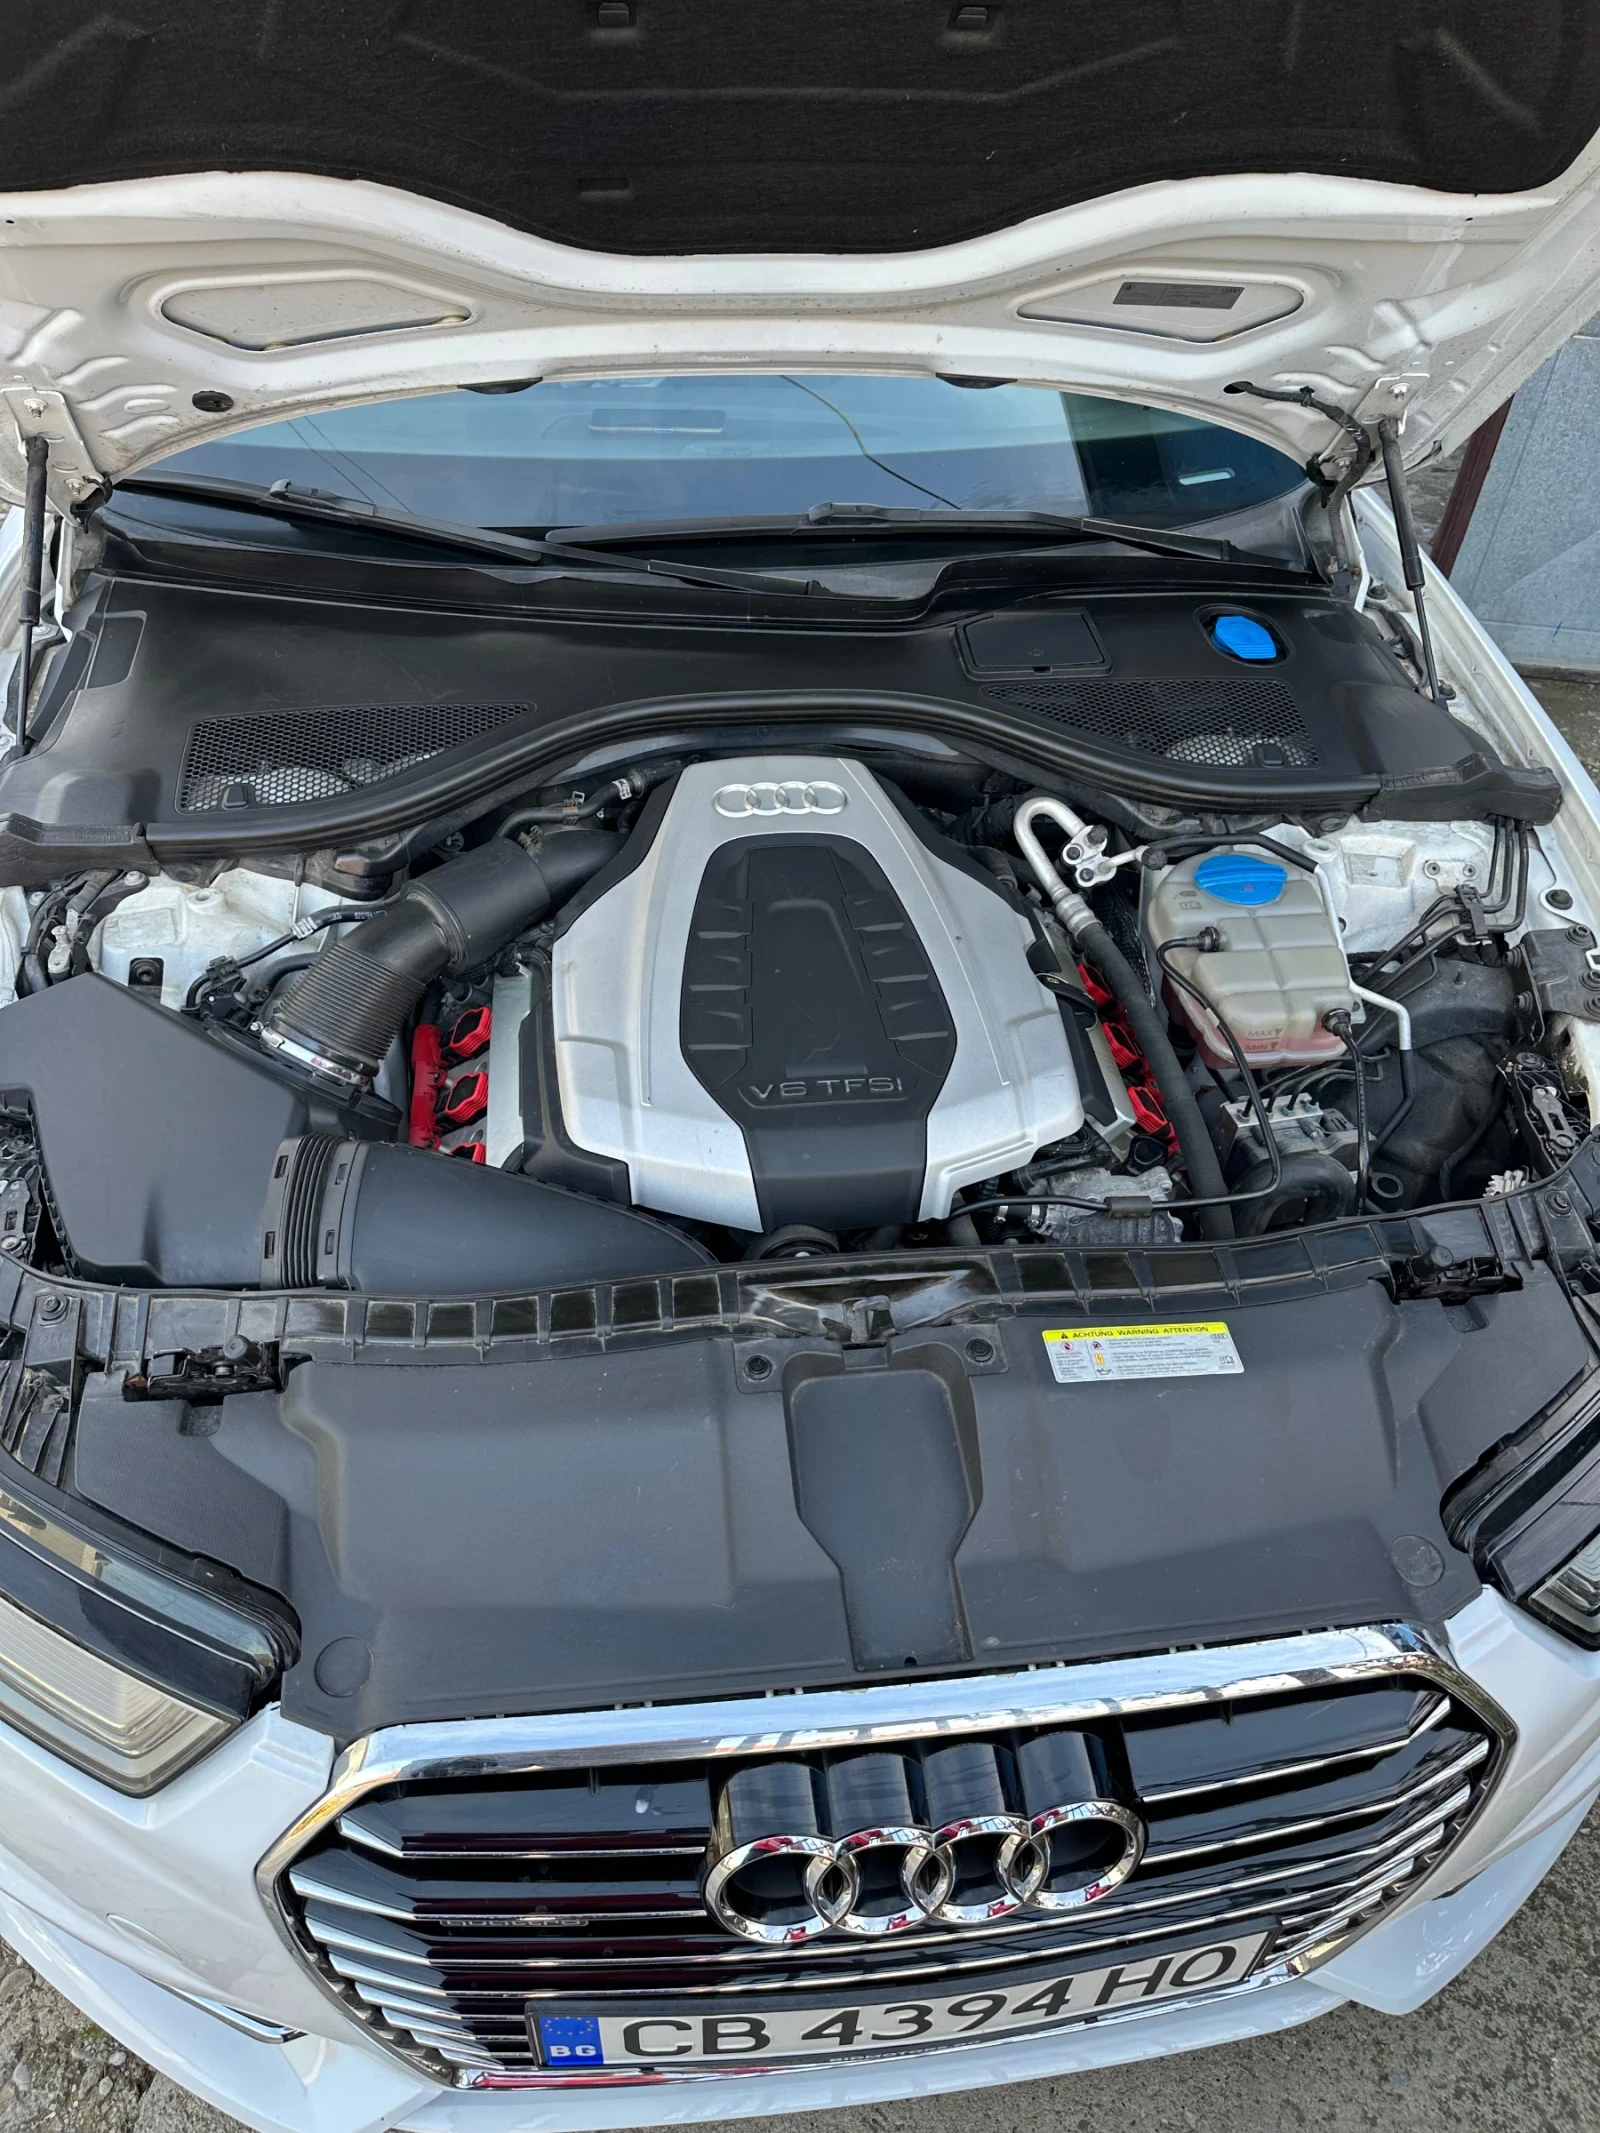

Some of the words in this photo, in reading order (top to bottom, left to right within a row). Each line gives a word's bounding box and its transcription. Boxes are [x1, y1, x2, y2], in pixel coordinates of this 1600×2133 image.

[1248, 1029, 1274, 1037] MAX
[750, 1081, 807, 1099] V6
[817, 1077, 903, 1096] TFSI
[1072, 1330, 1114, 1339] ACHTUNG
[1116, 1327, 1160, 1336] WARNING
[1163, 1325, 1209, 1334] ATTENTION
[623, 2016, 771, 2057] CB
[801, 1977, 1075, 2046] 4394
[1094, 1945, 1237, 2007] HO
[549, 2044, 597, 2058] BG
